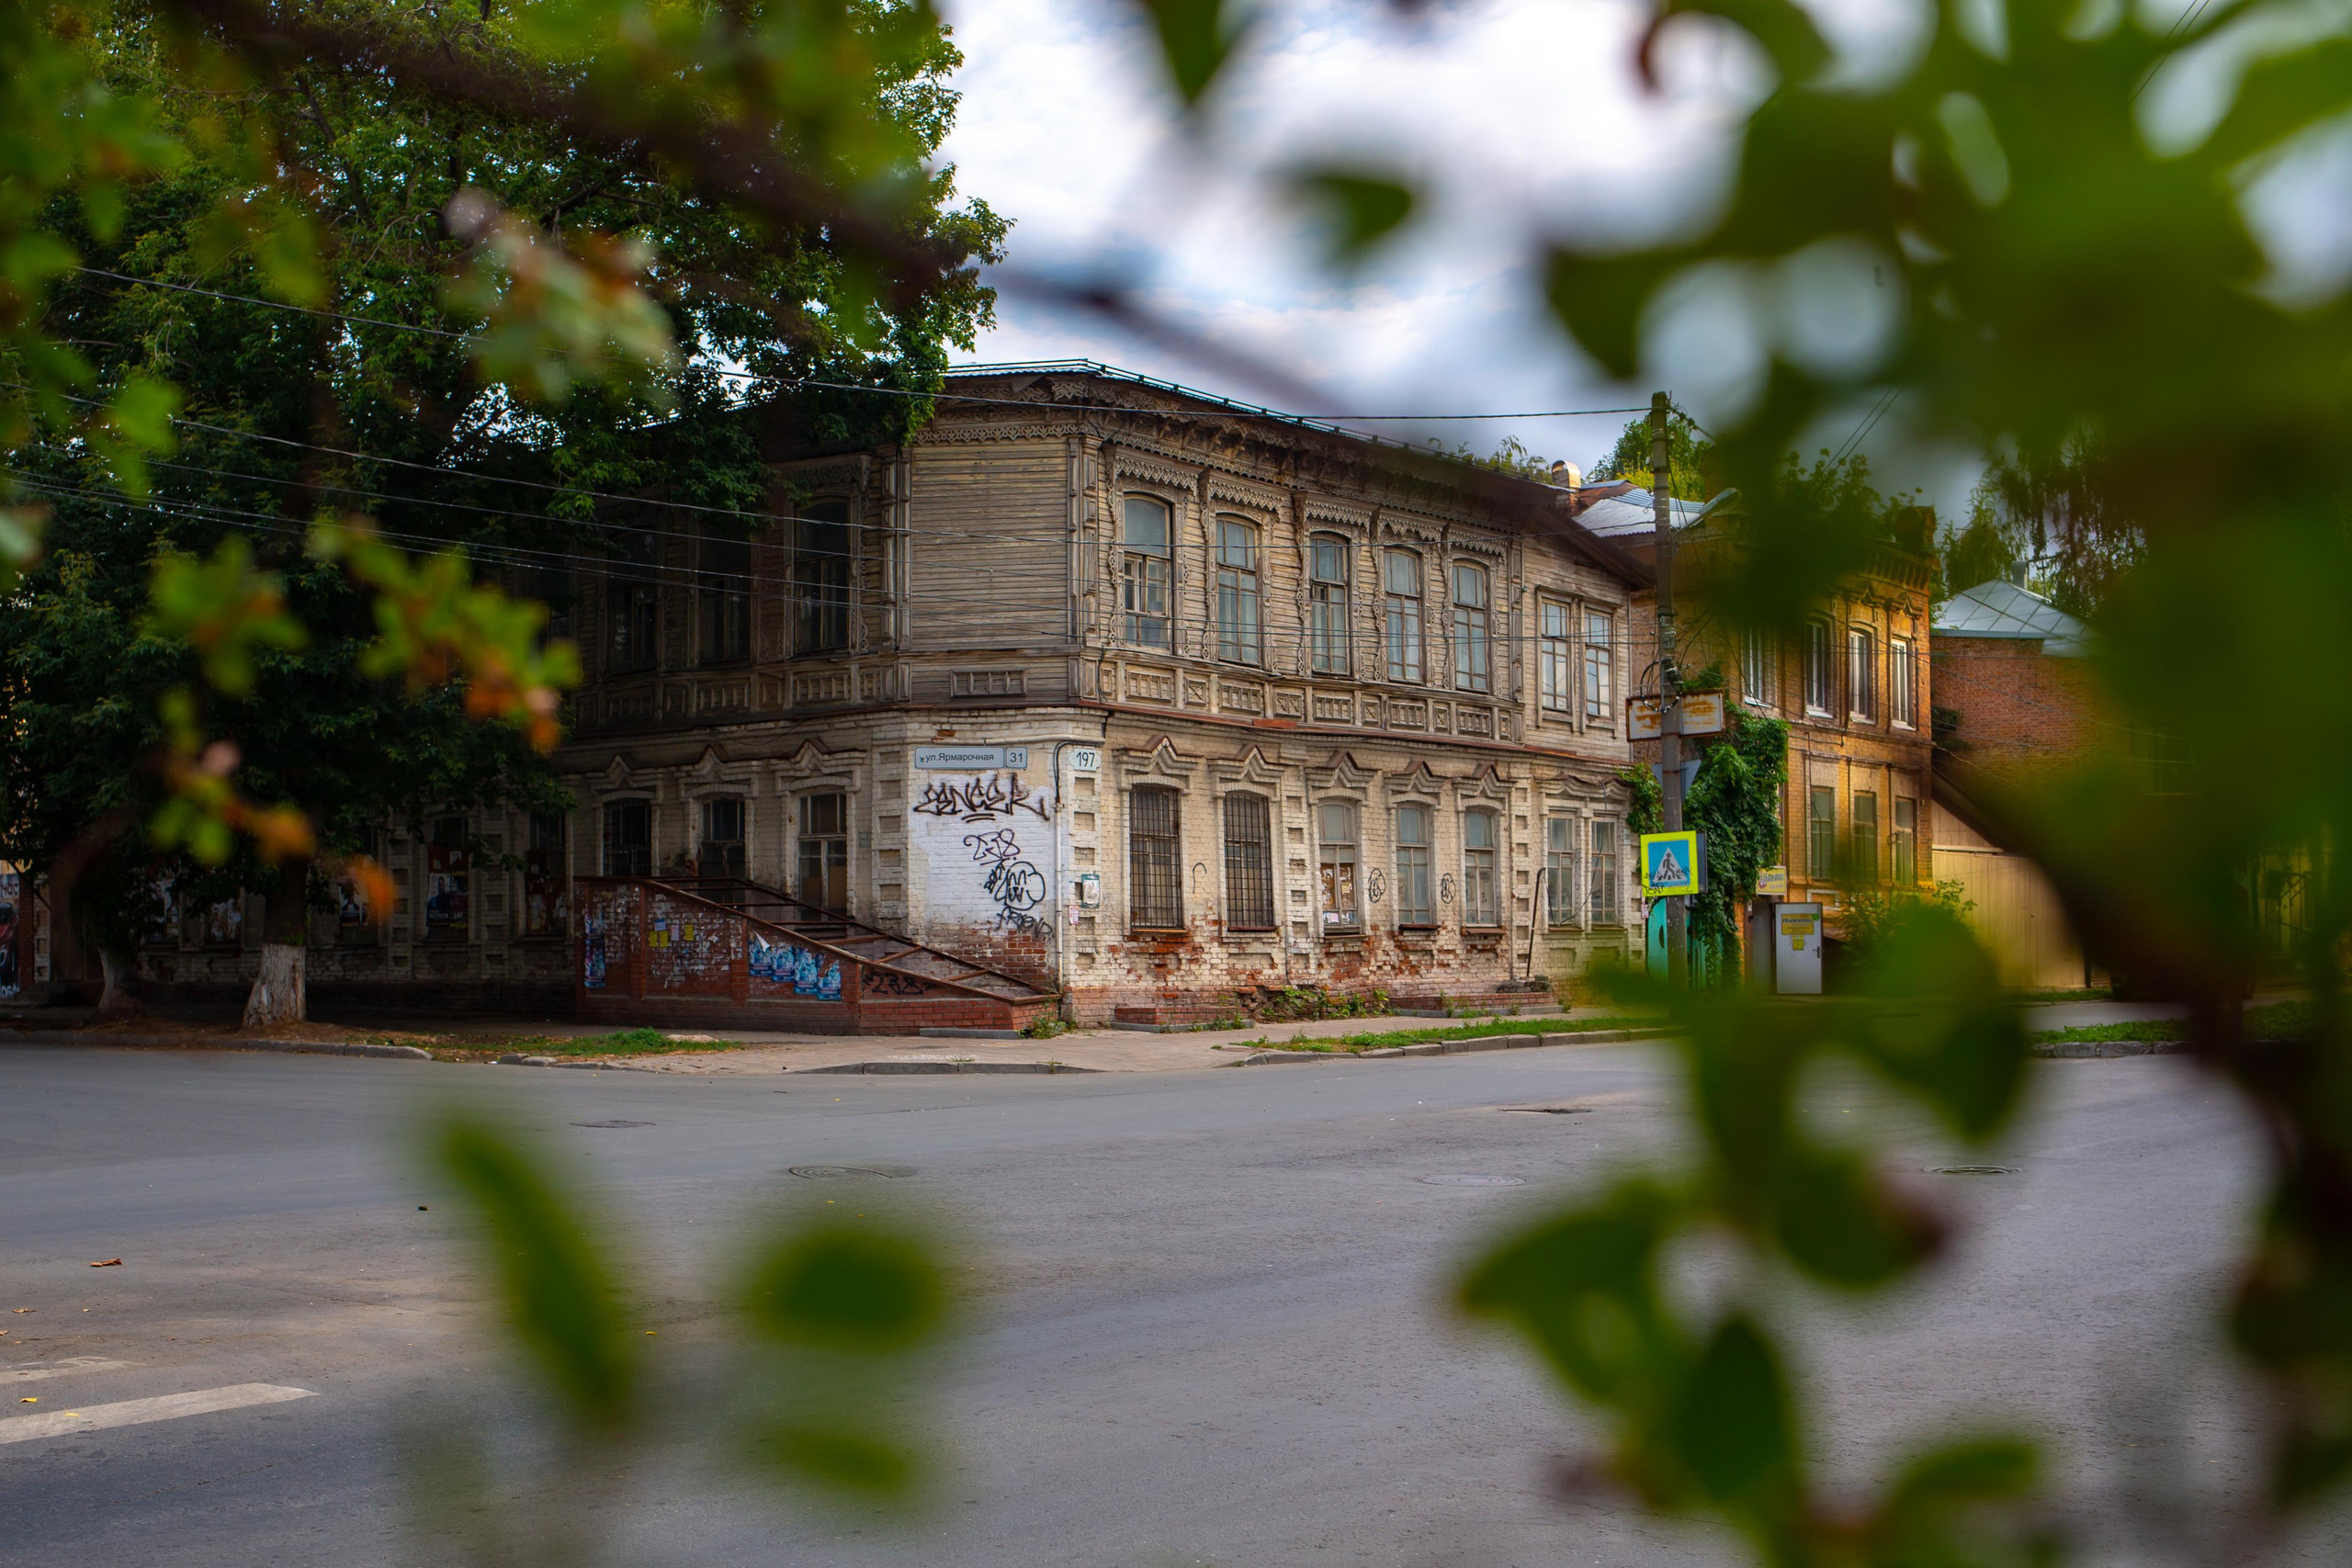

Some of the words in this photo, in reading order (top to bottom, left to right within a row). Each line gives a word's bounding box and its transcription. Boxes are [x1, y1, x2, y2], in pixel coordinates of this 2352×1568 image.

[925, 752, 994, 764] ул.Ярмарочная
[1010, 752, 1023, 763] 31
[1076, 751, 1095, 768] 197
